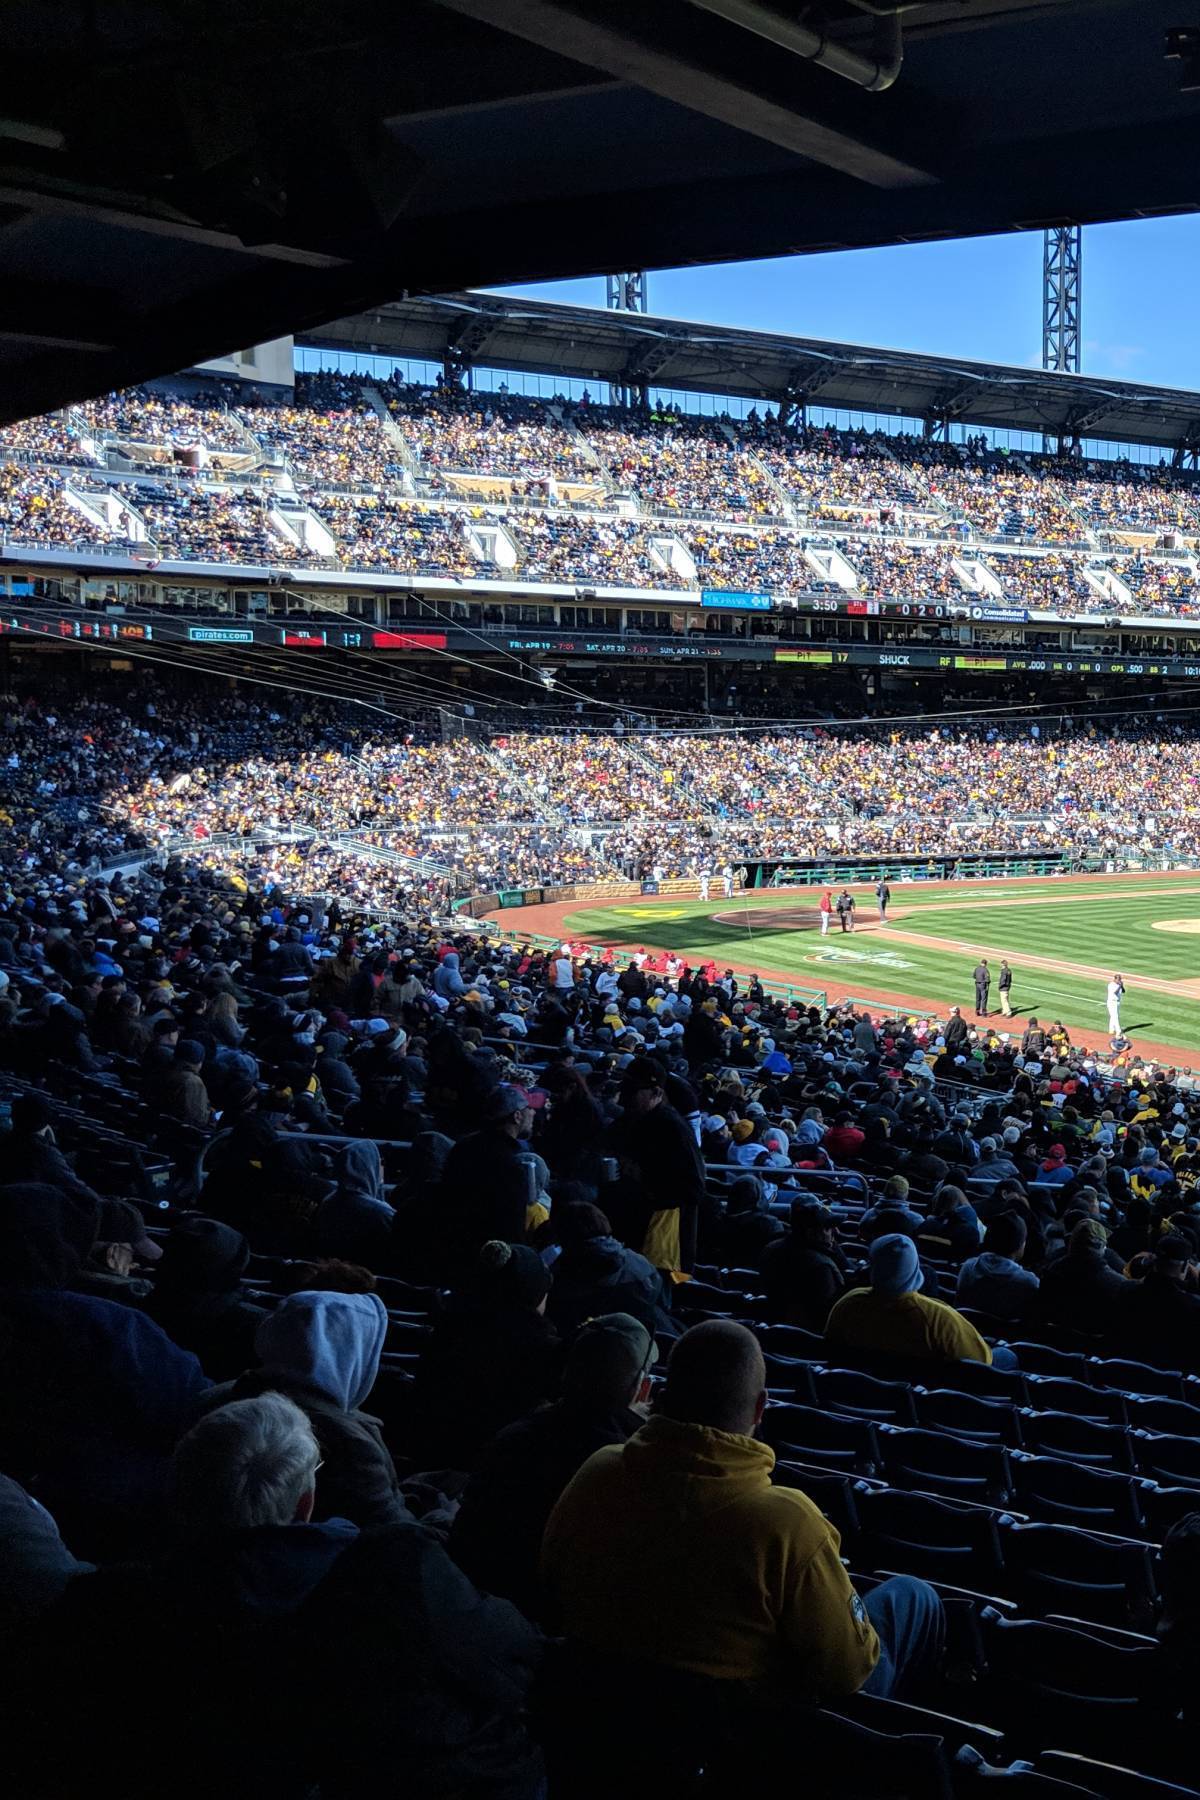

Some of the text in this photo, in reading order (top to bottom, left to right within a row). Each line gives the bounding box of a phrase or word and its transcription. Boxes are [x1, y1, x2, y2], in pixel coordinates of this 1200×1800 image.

[812, 599, 838, 611] 3:50
[902, 604, 910, 615] 0
[919, 605, 926, 616] 2
[935, 606, 943, 617] 0
[984, 608, 1024, 617] Consolidated
[195, 630, 249, 640] pirates.com
[837, 653, 849, 663] 17
[879, 654, 910, 665] SHUCK
[940, 657, 950, 666] RF
[1012, 661, 1026, 669] AVG
[1028, 660, 1046, 670] .000
[1066, 662, 1073, 671] 0
[1095, 663, 1101, 672] 0
[1111, 664, 1124, 672] OPS
[1127, 664, 1143, 674] .500
[1162, 666, 1168, 674] 2
